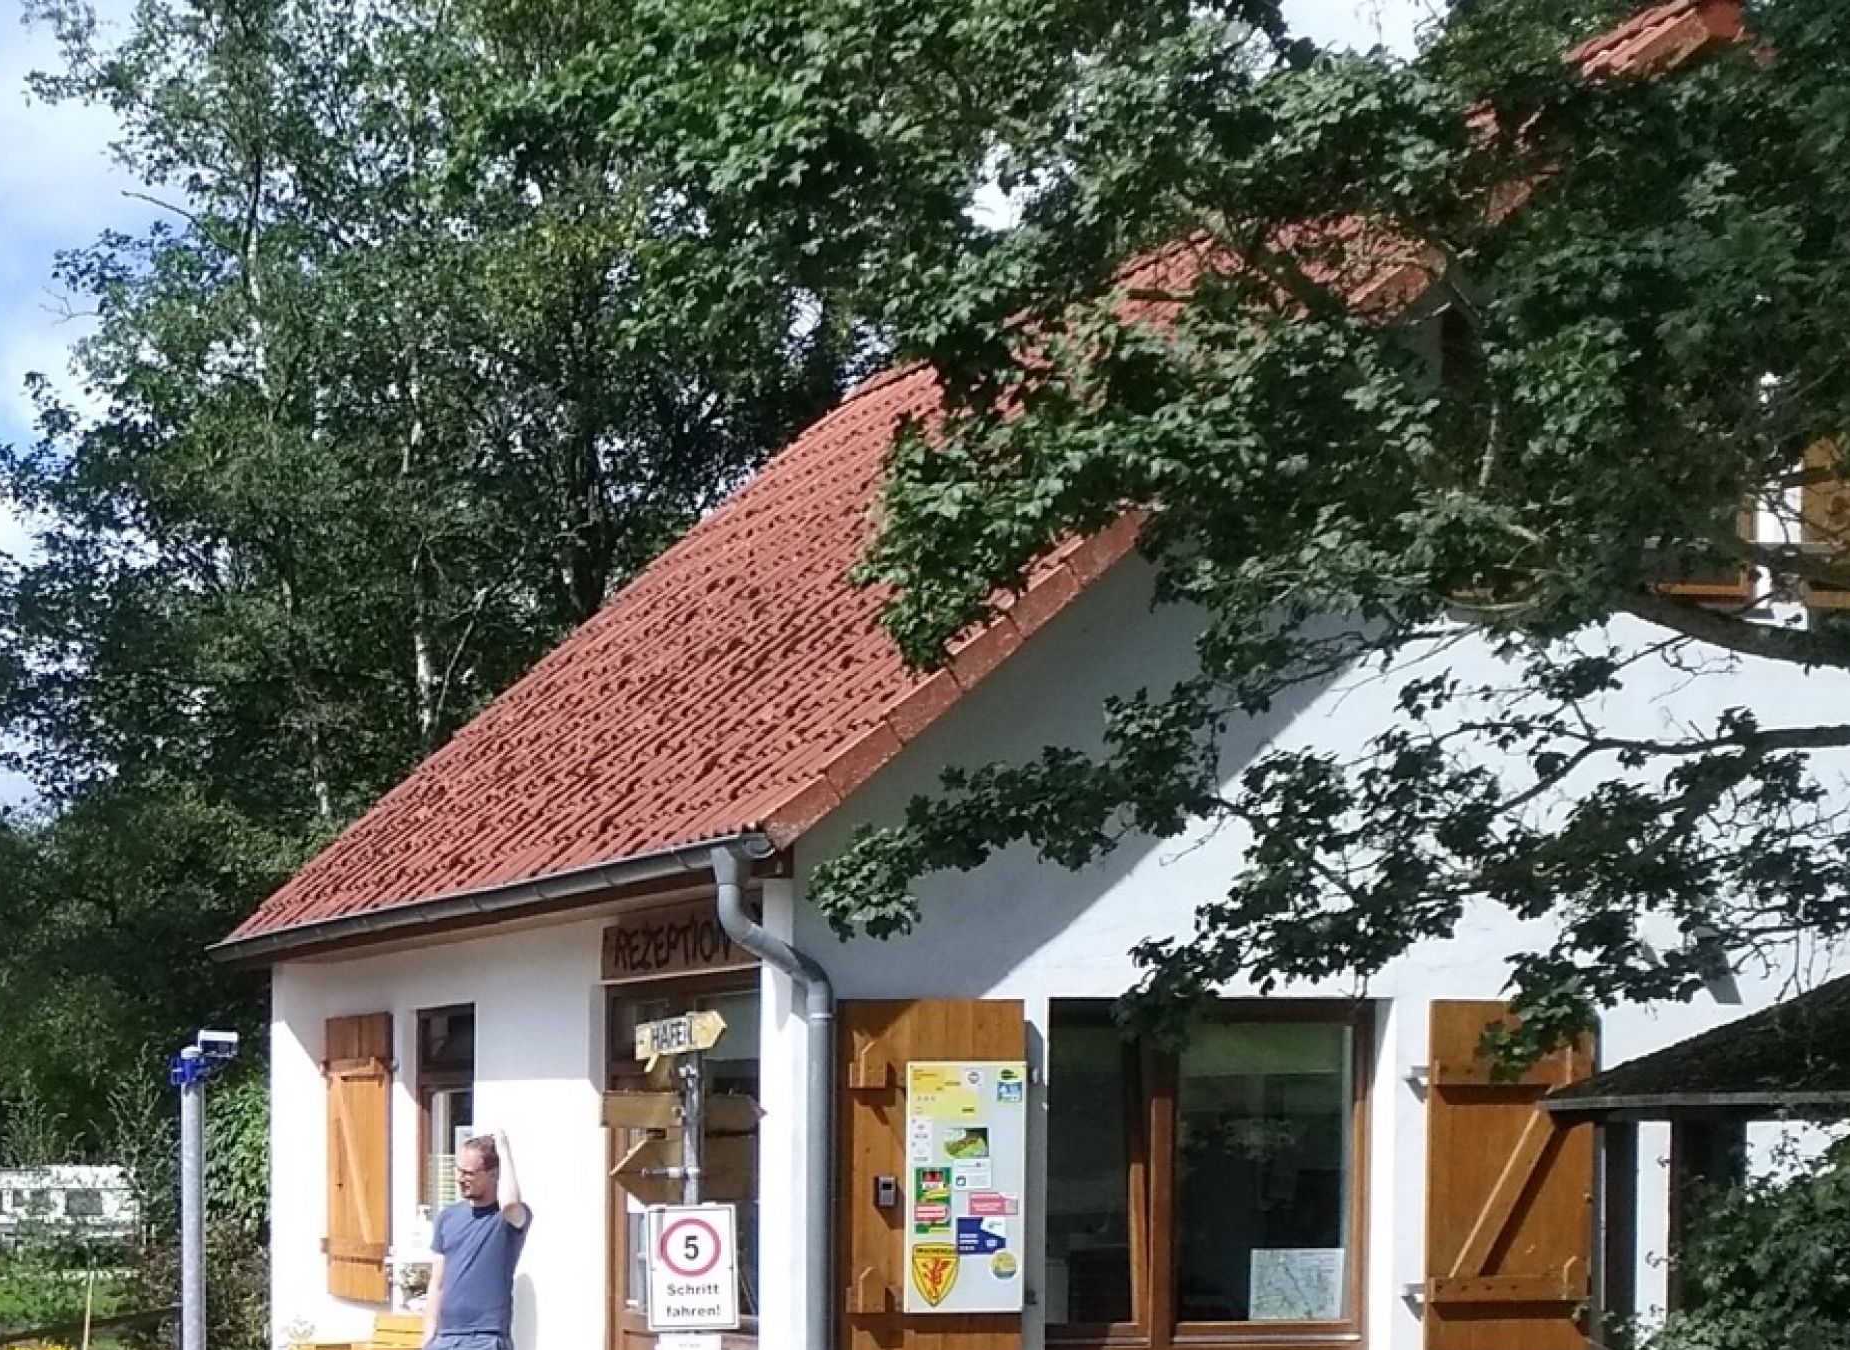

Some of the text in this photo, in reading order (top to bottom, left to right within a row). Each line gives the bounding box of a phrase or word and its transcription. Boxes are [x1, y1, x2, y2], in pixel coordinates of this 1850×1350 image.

[684, 1235, 700, 1261] 5
[666, 1283, 720, 1296] Schritt
[666, 1304, 721, 1317] fahren!
